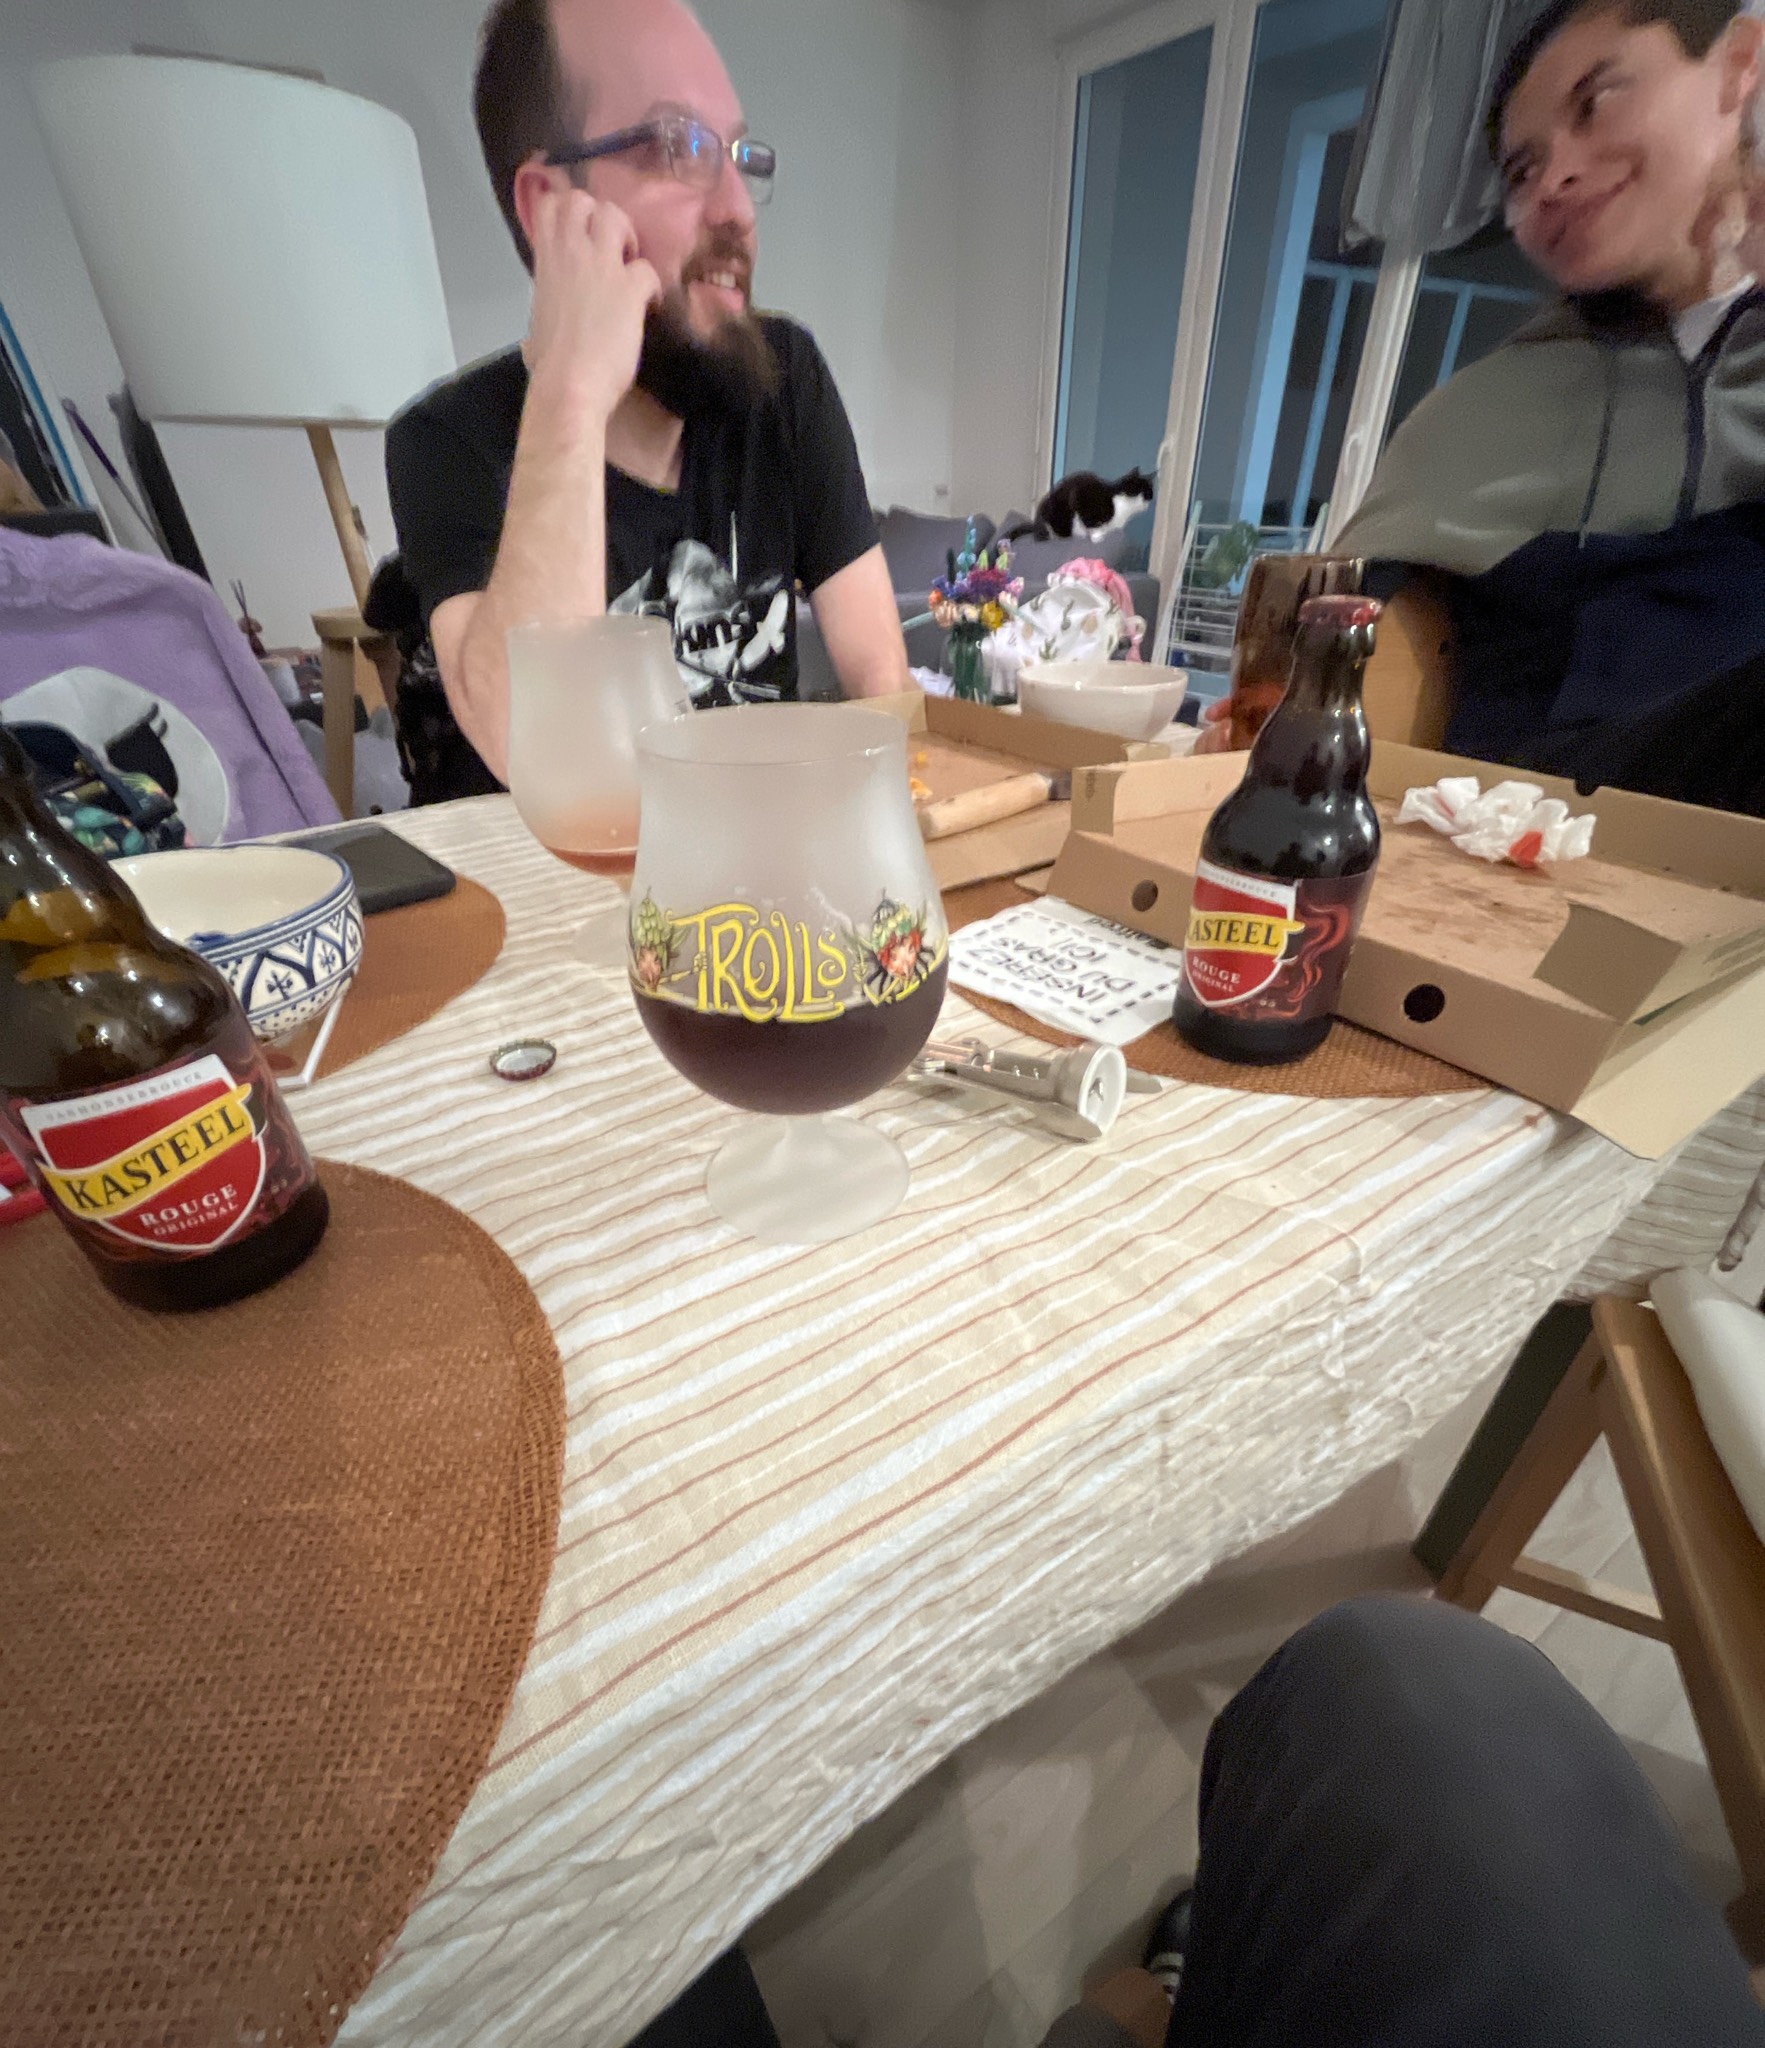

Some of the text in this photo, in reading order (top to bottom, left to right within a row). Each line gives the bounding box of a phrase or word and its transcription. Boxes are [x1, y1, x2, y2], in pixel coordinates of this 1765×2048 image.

[1187, 918, 1281, 948] ASTEEL
[664, 903, 848, 1024] TROLLS
[1192, 955, 1241, 984] ROUGE
[64, 1104, 246, 1211] KASTEEL
[139, 1183, 239, 1227] ROUGE
[153, 1200, 239, 1236] ORIGINAL
